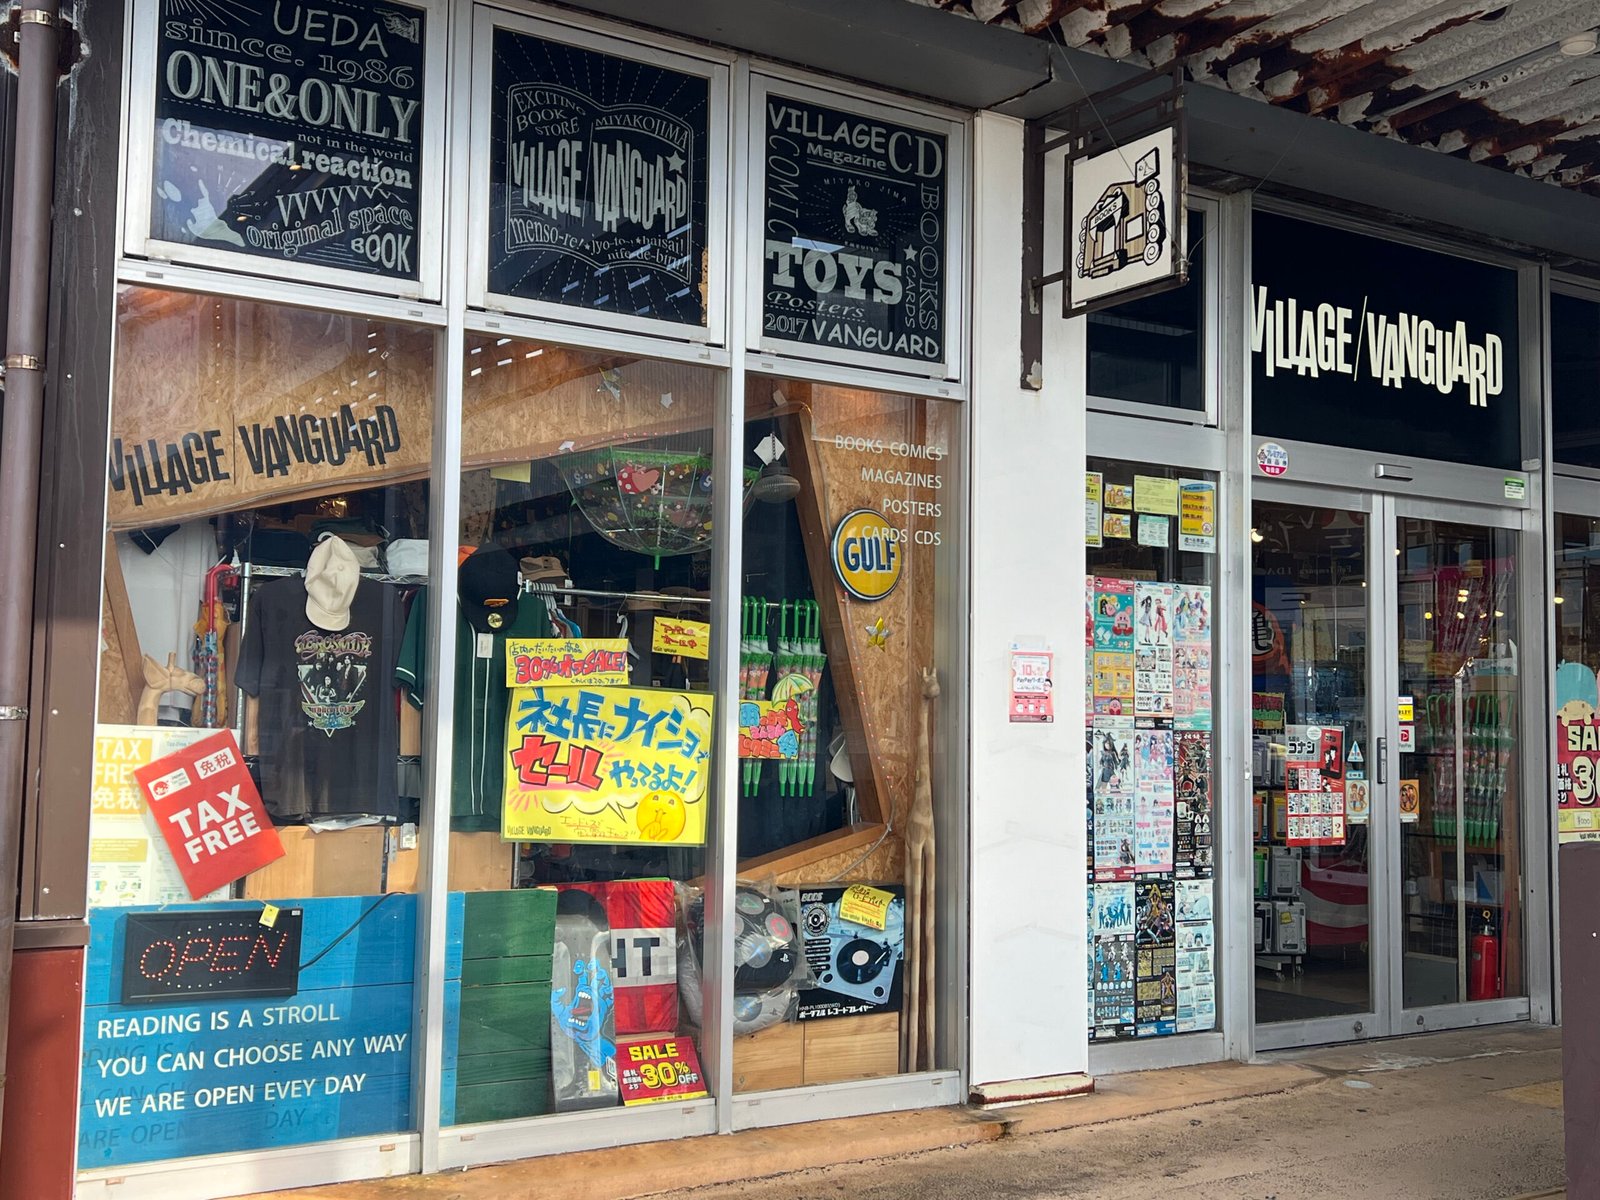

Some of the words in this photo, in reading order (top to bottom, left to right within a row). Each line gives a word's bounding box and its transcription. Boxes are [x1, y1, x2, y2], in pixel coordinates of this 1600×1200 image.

[164, 18, 305, 66] since.
[318, 53, 415, 90] 1986
[166, 50, 420, 143] ONE&ONLY
[513, 90, 586, 115] EXCITING
[516, 108, 567, 133] BOOK
[536, 117, 580, 137] STORE
[595, 114, 689, 149] MIYAKOJIMA
[768, 103, 887, 153] VILLAGE
[161, 117, 296, 166] Chemical
[302, 148, 412, 189] reaction
[297, 133, 322, 147] not
[327, 135, 340, 149] in
[345, 138, 367, 154] the
[372, 145, 413, 163] world
[807, 142, 888, 171] Magazine
[888, 131, 942, 179] CD
[512, 139, 582, 220] VILLAGE
[593, 140, 687, 233] VANGUARD
[767, 135, 800, 236] COMIC
[823, 177, 870, 188] MIYAKO
[246, 208, 344, 258] Original
[348, 203, 413, 233] space
[1095, 202, 1117, 223] BOOKS
[351, 232, 411, 273] BOOK
[919, 183, 940, 331] BOOKS
[766, 239, 903, 304] TOYS
[767, 290, 865, 318] Posters
[905, 265, 916, 329] CARDS
[765, 313, 808, 340] 2017
[811, 318, 939, 358] VANGUARD
[1251, 284, 1352, 378] VILLAGE
[1367, 312, 1503, 407] VANGUARD
[109, 430, 230, 506] VILLAGE
[238, 404, 401, 478] VANGUARD
[835, 435, 883, 453] BOOKS
[889, 442, 942, 461] COMICS
[861, 467, 942, 489] MAGAZINES
[883, 498, 941, 518] POSTERS
[862, 525, 907, 543] CARDS
[914, 530, 941, 546] CDS
[843, 537, 896, 573] GULF
[97, 739, 141, 760] TAX
[1289, 741, 1315, 754] コナン
[1568, 726, 1600, 751] SA
[200, 752, 231, 776] 免税
[510, 735, 604, 791] セール
[93, 786, 141, 811] 免税
[169, 783, 251, 838] TAX
[184, 812, 261, 864] FREE
[140, 931, 289, 979] OPEN
[97, 1013, 201, 1038] READING
[210, 1011, 229, 1030] IS
[237, 1010, 253, 1028] A
[262, 1003, 340, 1027] STROLL
[97, 1054, 147, 1078] YOU
[156, 1051, 204, 1073] CAN
[214, 1042, 303, 1068] CHOOSE
[311, 1038, 355, 1059] ANY
[363, 1033, 408, 1054] WAY
[628, 1043, 679, 1061] SALE
[95, 1095, 132, 1118] WE
[141, 1091, 185, 1113] ARE
[194, 1085, 254, 1108] OPEN
[264, 1080, 316, 1100] EVEY
[325, 1073, 366, 1095] DAY
[678, 1073, 698, 1084] OFF
